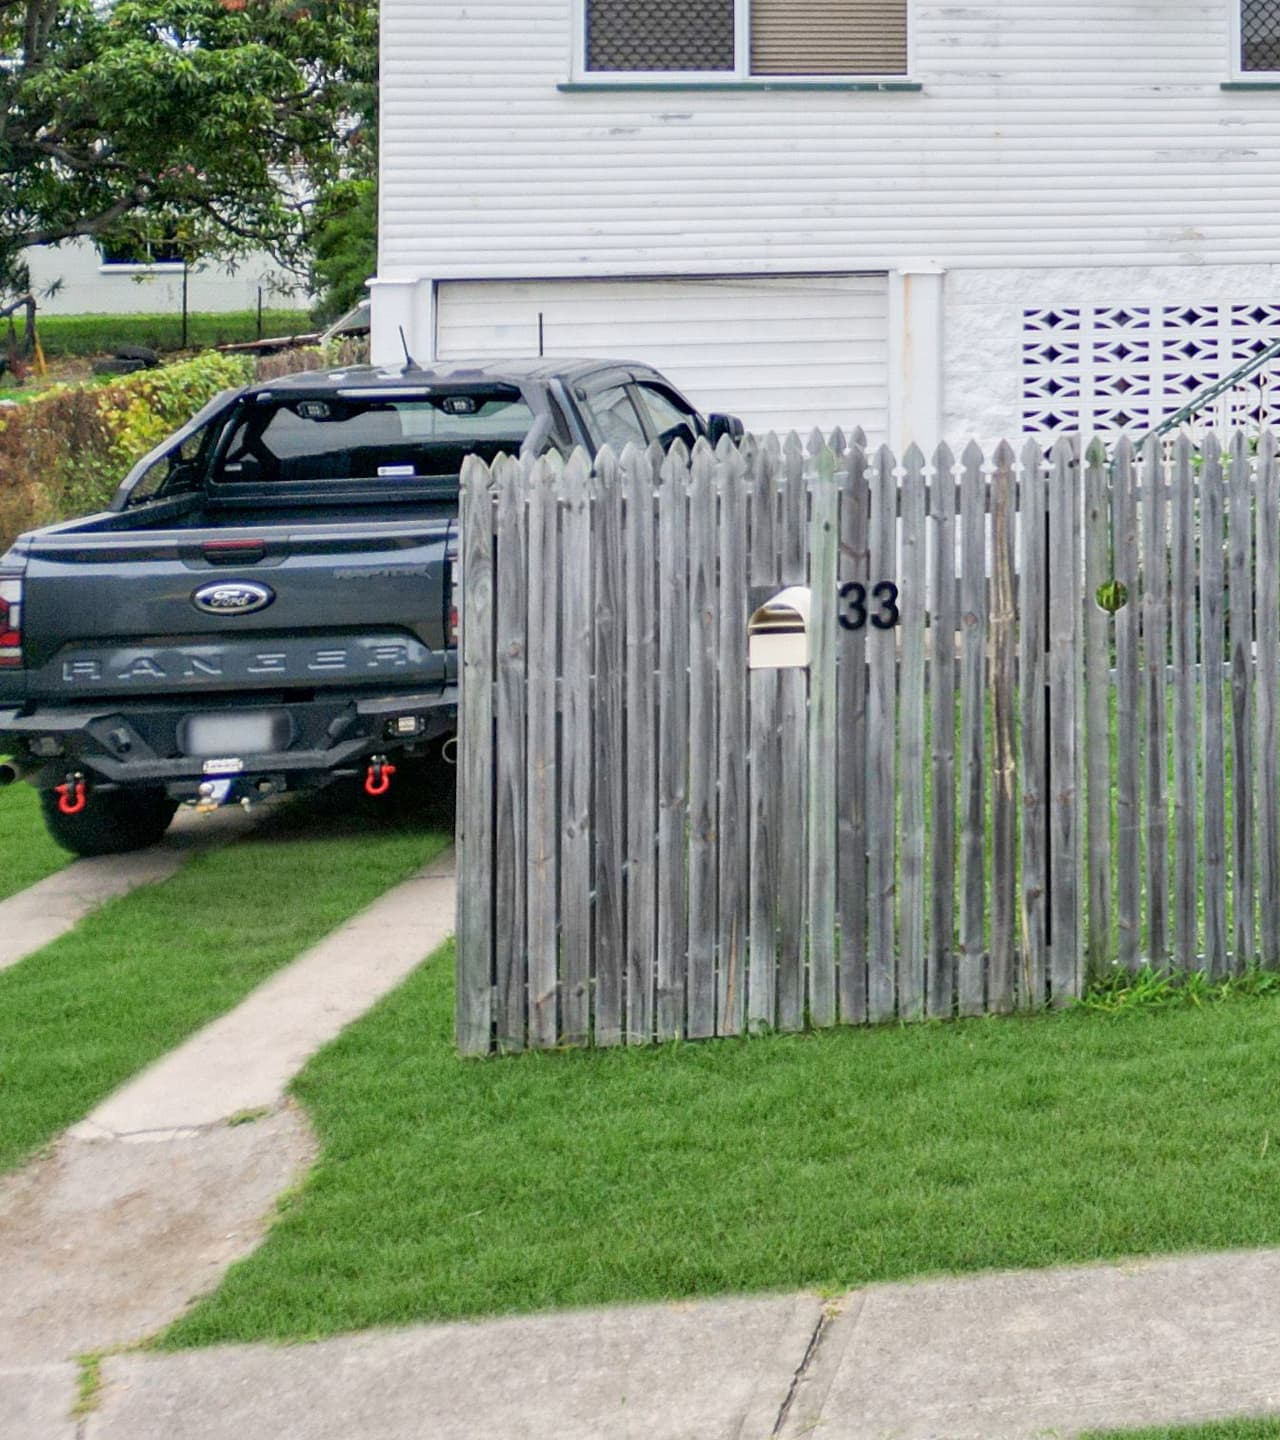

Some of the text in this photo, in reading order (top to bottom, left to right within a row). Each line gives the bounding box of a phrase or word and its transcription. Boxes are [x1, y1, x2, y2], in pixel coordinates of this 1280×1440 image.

[208, 590, 252, 609] Ford
[838, 581, 900, 631] 33
[62, 643, 409, 682] RANGER
